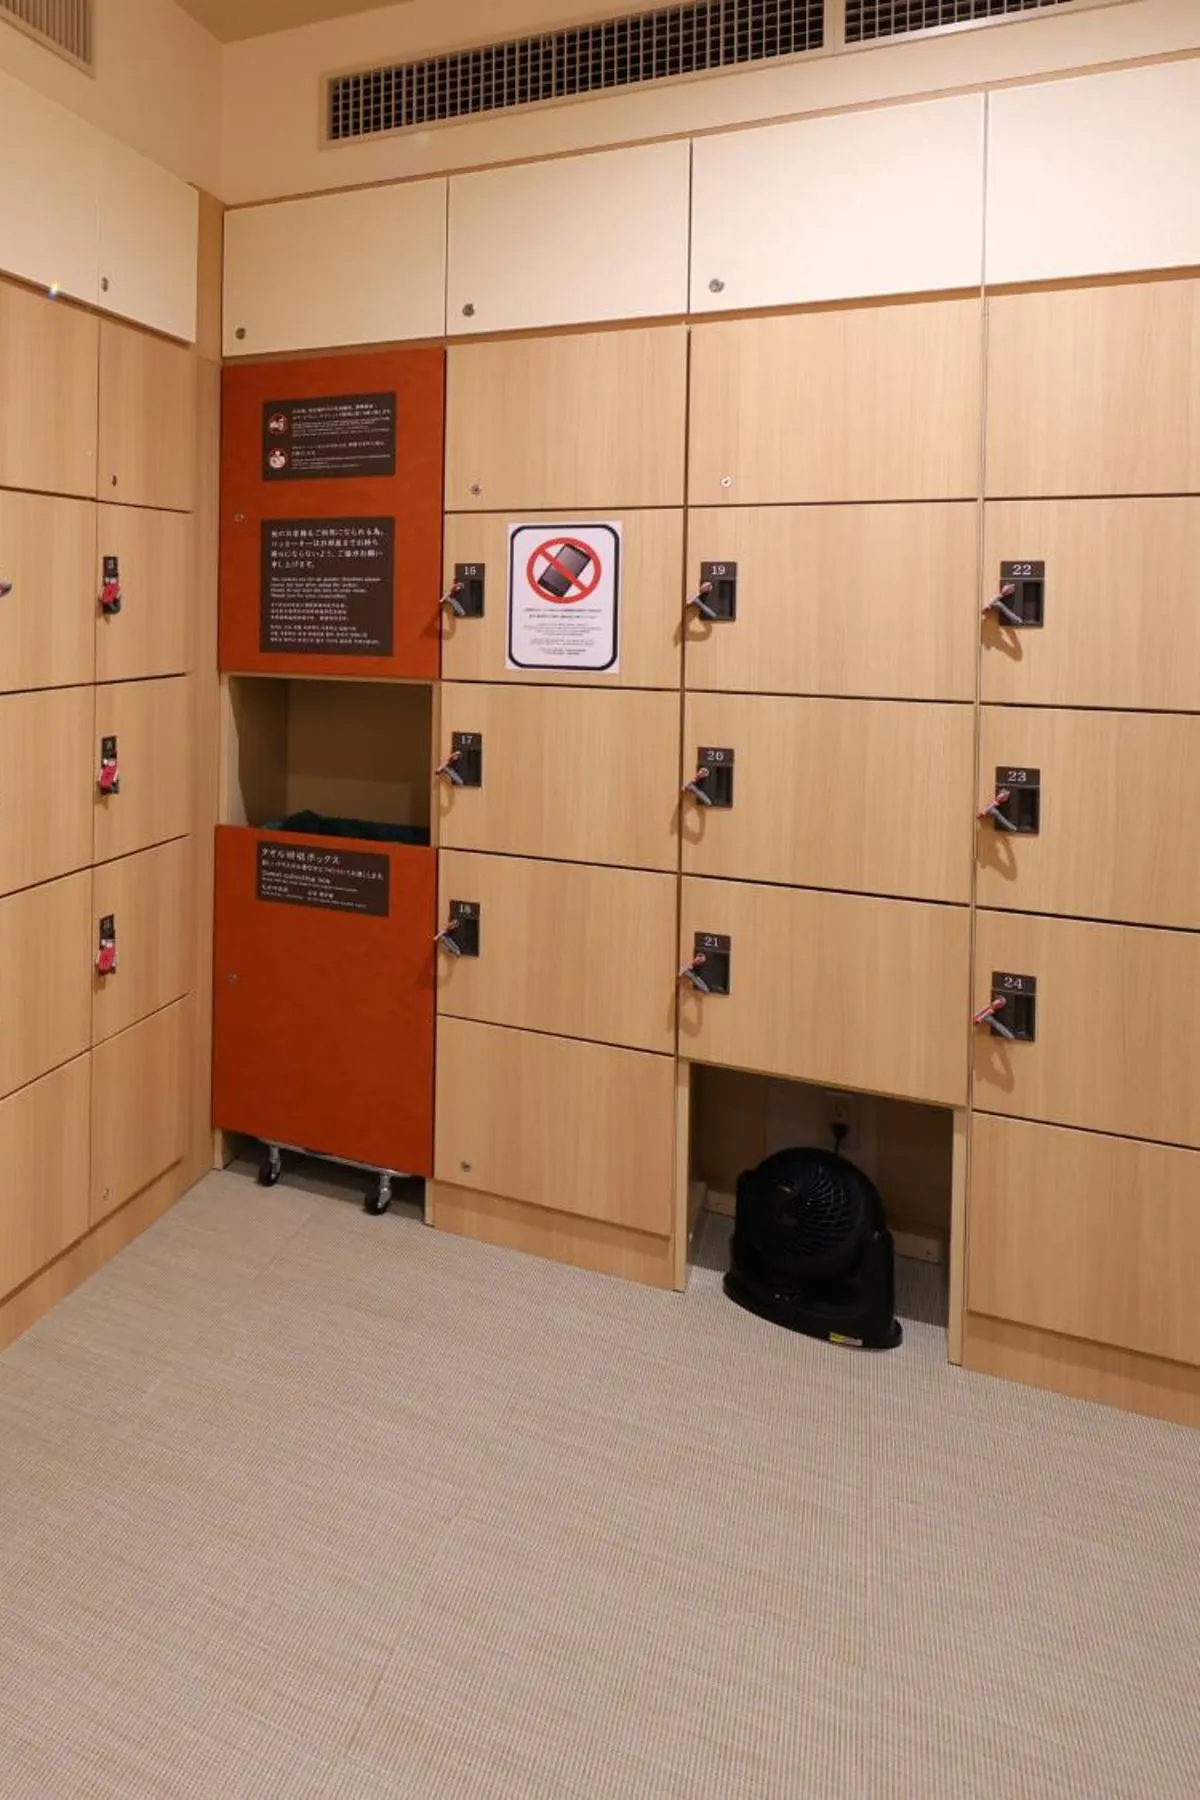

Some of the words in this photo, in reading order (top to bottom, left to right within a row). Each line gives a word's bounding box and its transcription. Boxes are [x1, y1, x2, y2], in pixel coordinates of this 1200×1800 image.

[464, 566, 476, 576] 16
[711, 565, 726, 576] 19
[1011, 564, 1032, 576] 22
[461, 735, 473, 745] 17
[707, 750, 724, 761] 20
[1007, 770, 1027, 782] 23
[704, 936, 719, 947] 21
[1004, 976, 1023, 989] 24
